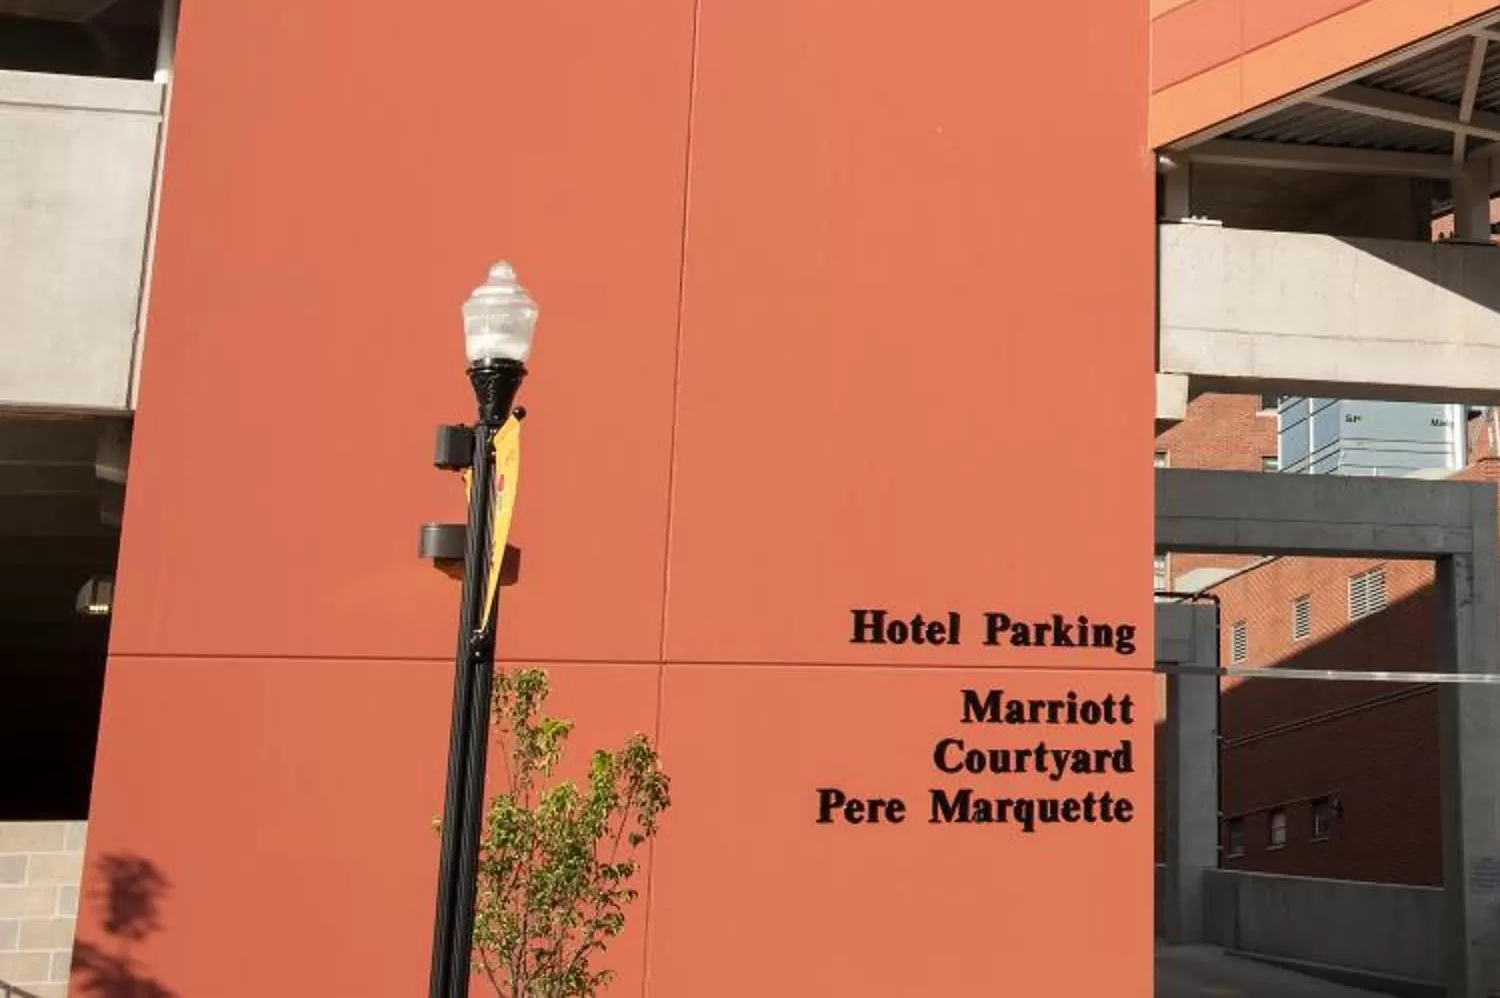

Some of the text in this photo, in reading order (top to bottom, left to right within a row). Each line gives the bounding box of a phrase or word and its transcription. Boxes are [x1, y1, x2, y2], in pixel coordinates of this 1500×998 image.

[850, 609, 1136, 655] Hotel Parking
[960, 689, 1134, 724] Marriott
[933, 738, 1134, 781] Courtyard
[815, 788, 1134, 833] Pere Marquette
